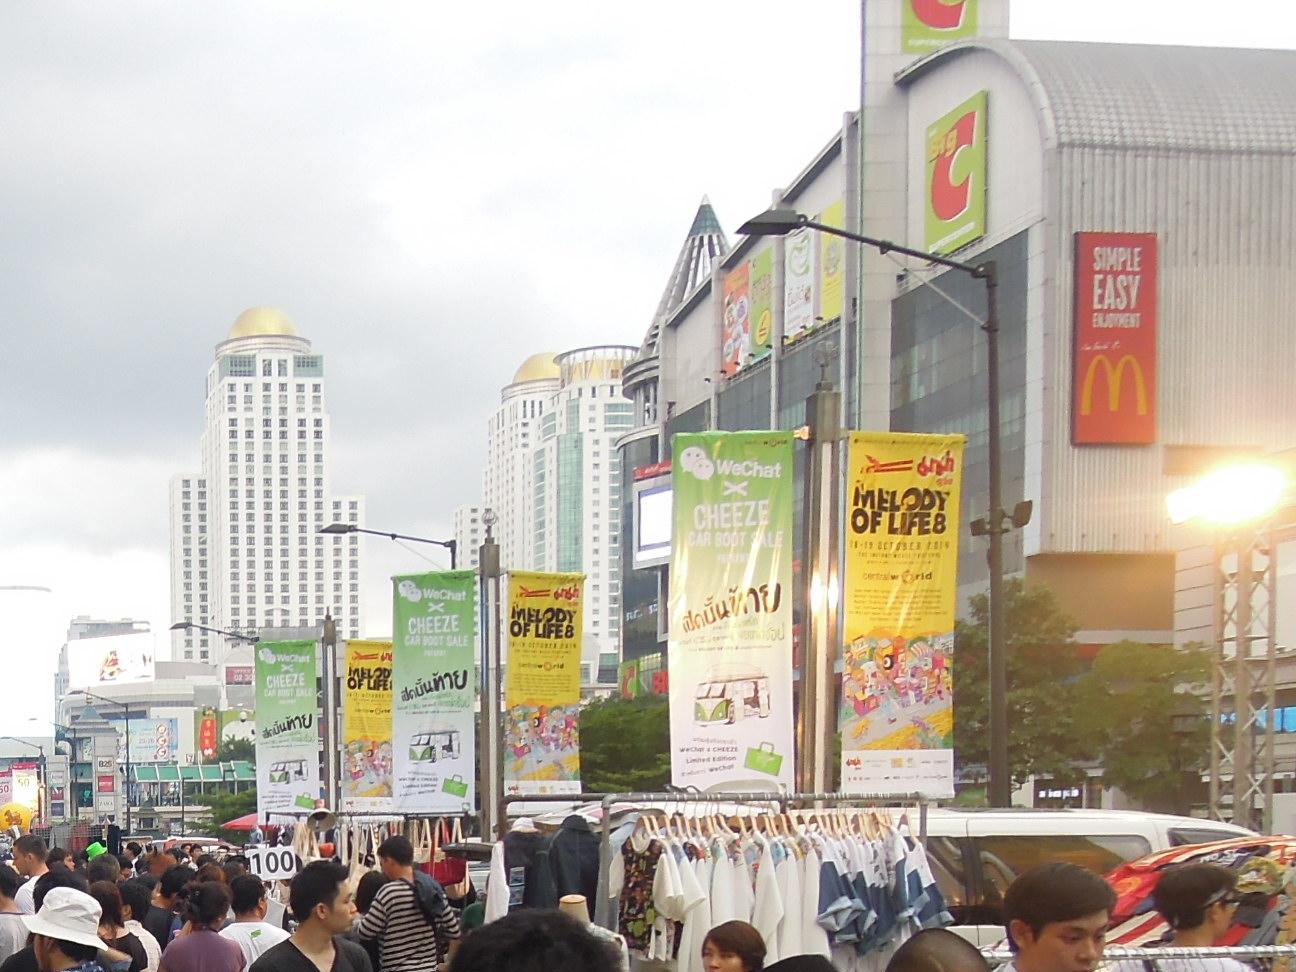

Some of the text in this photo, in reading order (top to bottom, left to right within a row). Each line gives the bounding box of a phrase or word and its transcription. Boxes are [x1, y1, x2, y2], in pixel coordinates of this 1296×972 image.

[1092, 247, 1142, 271] SIMPLE
[1092, 274, 1140, 309] EASY
[1092, 312, 1141, 328] ENJOYMENT
[716, 459, 782, 479] WeChat
[853, 482, 951, 512] MELODY
[693, 499, 770, 531] CHEEZE
[851, 508, 946, 535] OF LIFE 8
[688, 531, 712, 548] CAR
[715, 531, 746, 548] BOOT
[423, 588, 467, 601] WeChat
[511, 605, 577, 624] MELODY
[408, 614, 460, 635] CHEEZE
[510, 620, 575, 639] OF LIFE 8
[446, 635, 469, 647] SALE
[276, 654, 310, 663] WeChat
[266, 672, 305, 688] CHEEZE
[348, 664, 392, 680] MELOD
[347, 677, 389, 691] OF LIFE
[252, 850, 294, 875] 100
